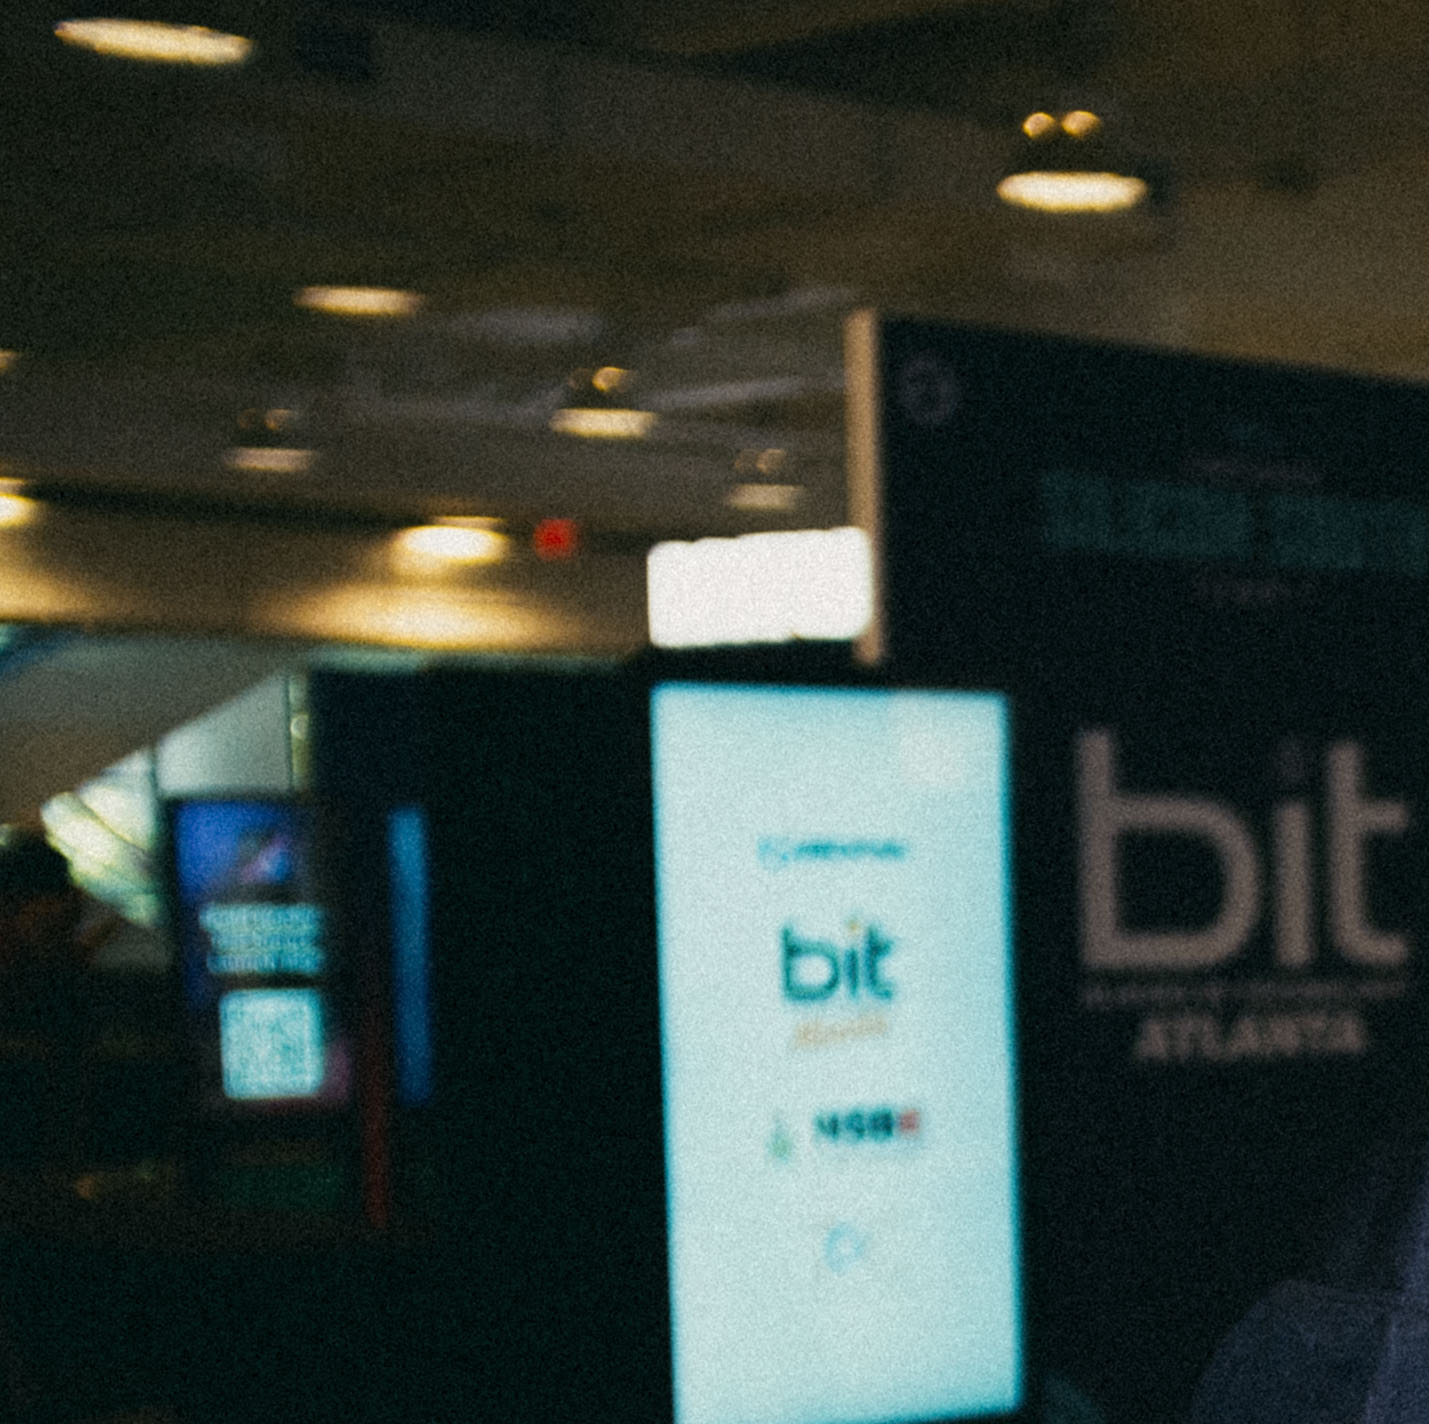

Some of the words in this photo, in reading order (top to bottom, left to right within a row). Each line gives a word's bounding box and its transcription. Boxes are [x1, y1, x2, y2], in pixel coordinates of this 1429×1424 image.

[1079, 727, 1410, 972] bit
[779, 912, 897, 1004] bit
[1133, 1010, 1370, 1063] ATLANTA
